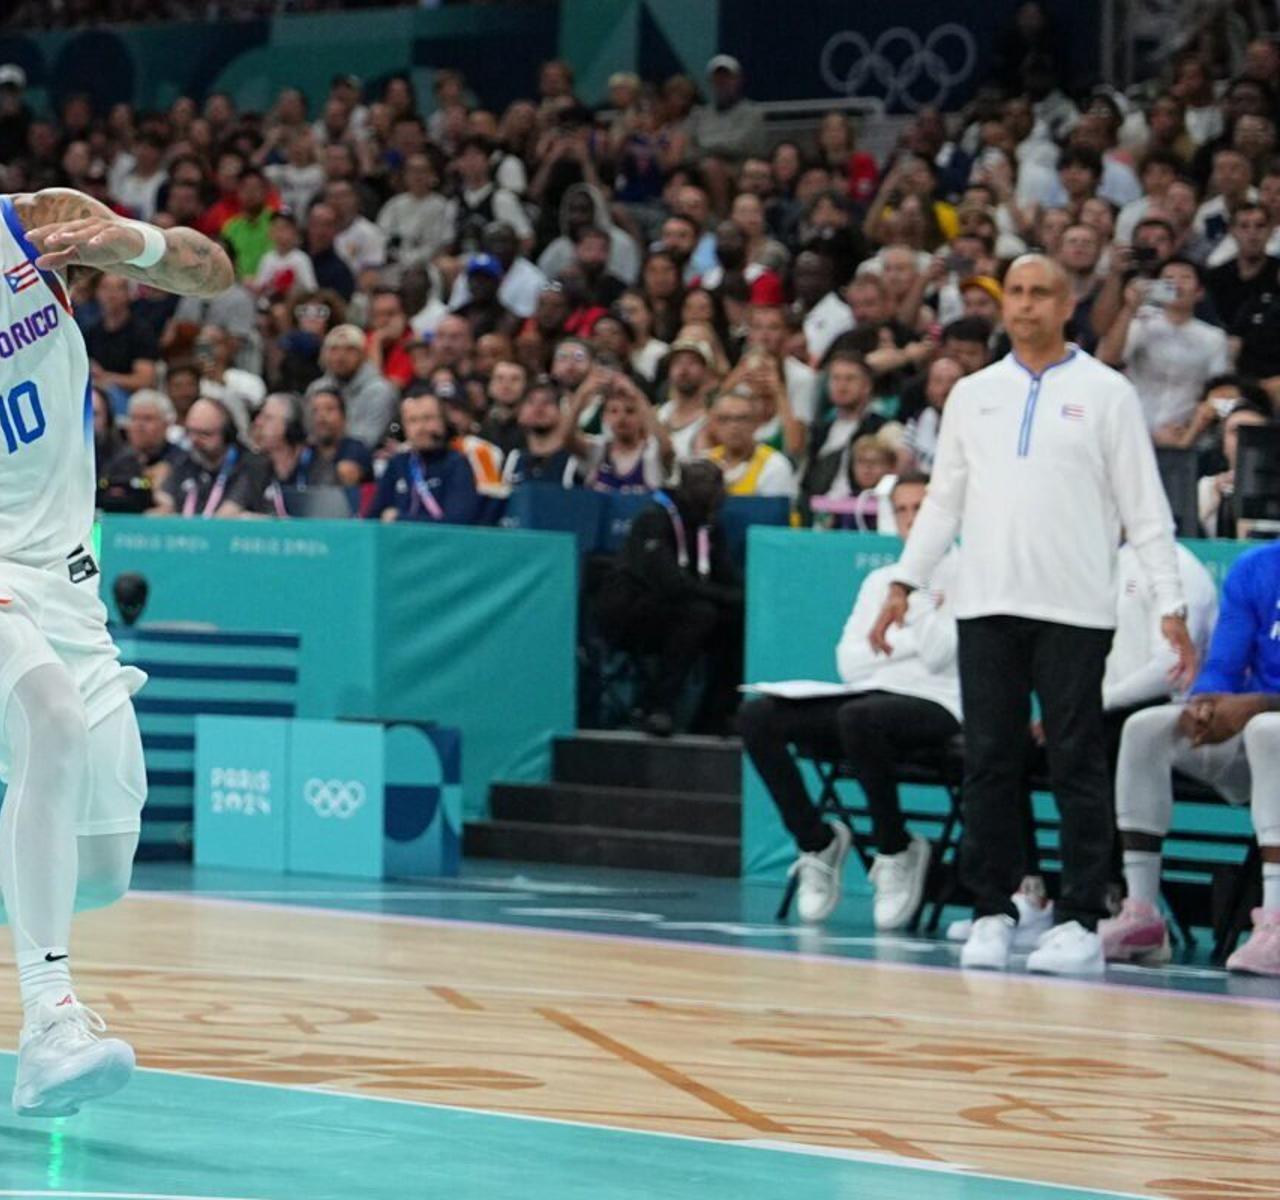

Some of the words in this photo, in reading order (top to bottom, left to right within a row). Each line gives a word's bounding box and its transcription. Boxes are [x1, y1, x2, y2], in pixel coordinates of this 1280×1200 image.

[12, 303, 59, 350] RICO
[210, 767, 272, 793] PARIS
[210, 789, 272, 817] 2024
